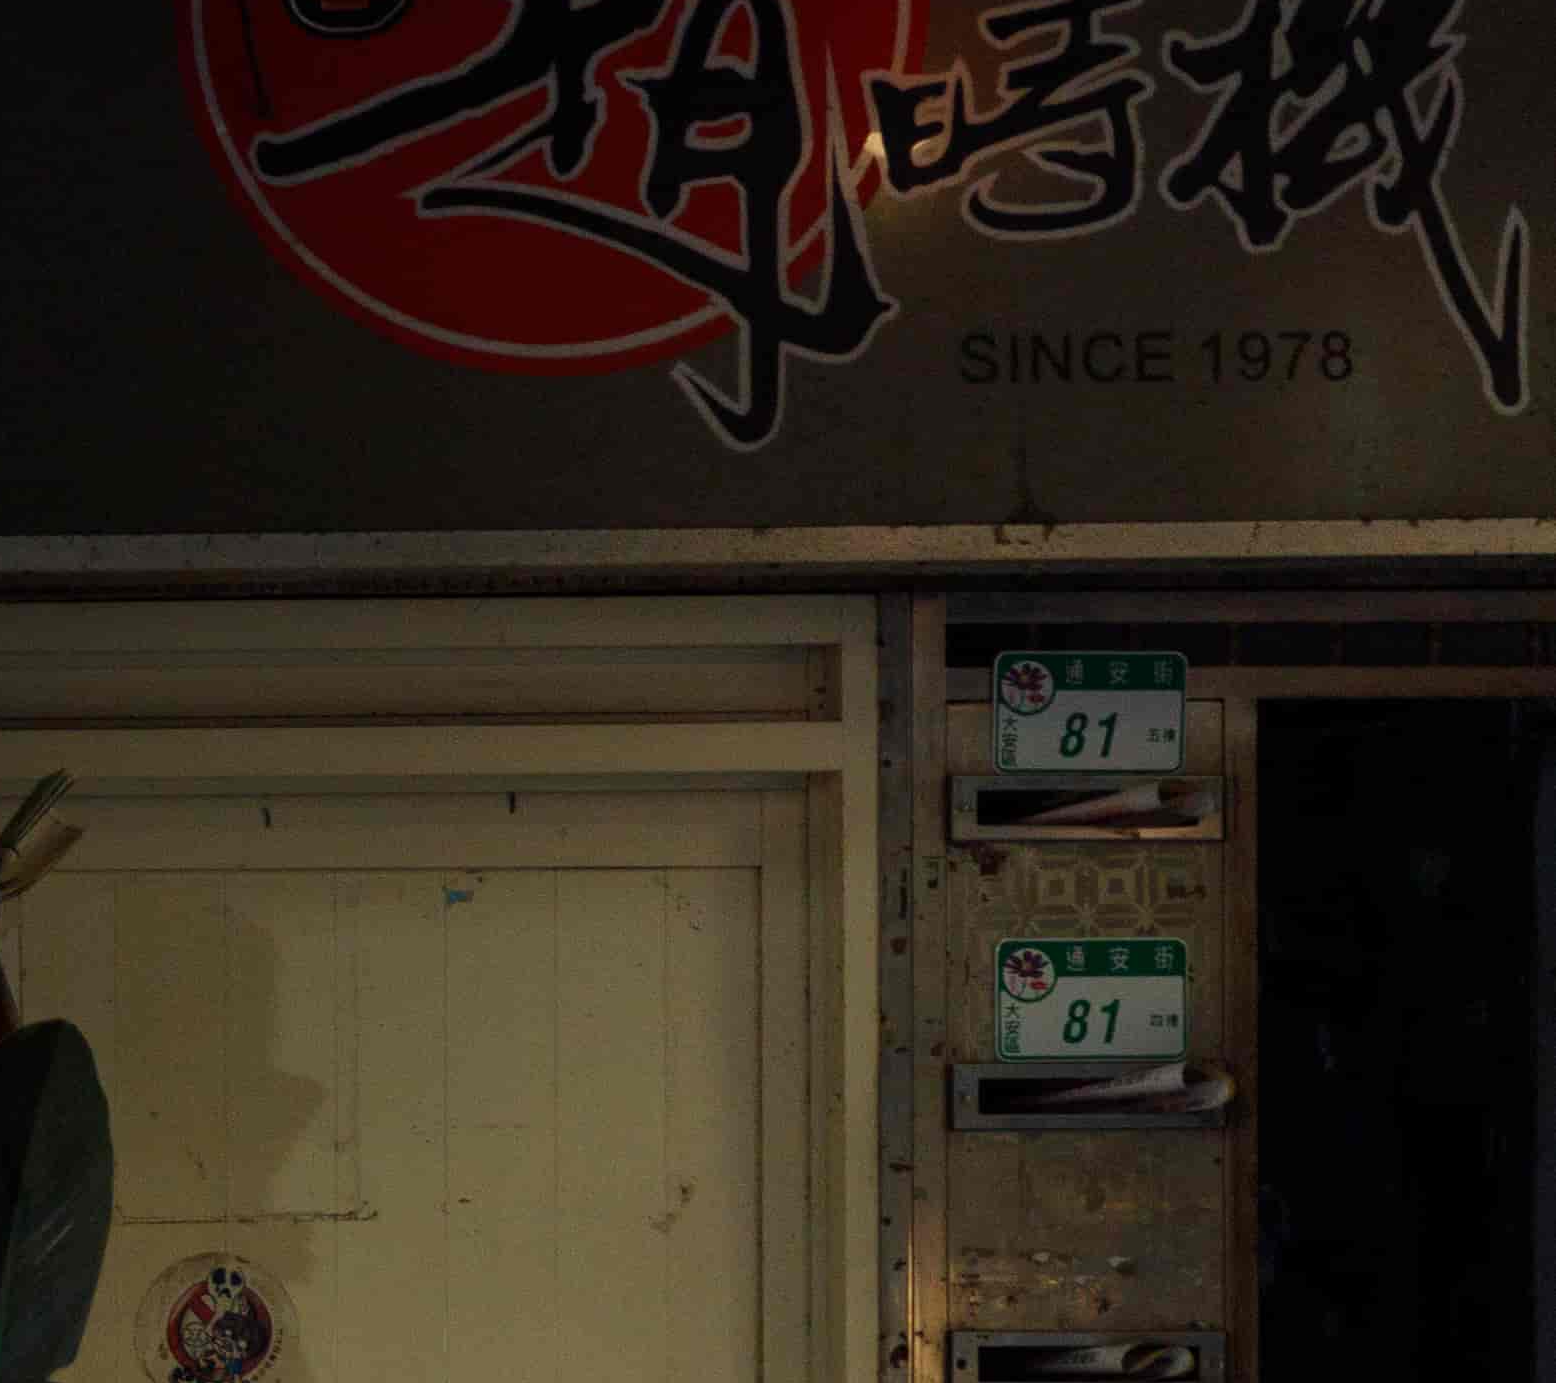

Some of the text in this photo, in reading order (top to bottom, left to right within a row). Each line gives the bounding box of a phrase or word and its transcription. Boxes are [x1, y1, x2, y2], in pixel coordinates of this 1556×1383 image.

[960, 329, 1356, 383] SINCE 1978
[1066, 661, 1174, 686] 通安街
[1061, 713, 1118, 757] 81
[1066, 947, 1176, 972] 通安街
[1063, 999, 1121, 1045] 81
